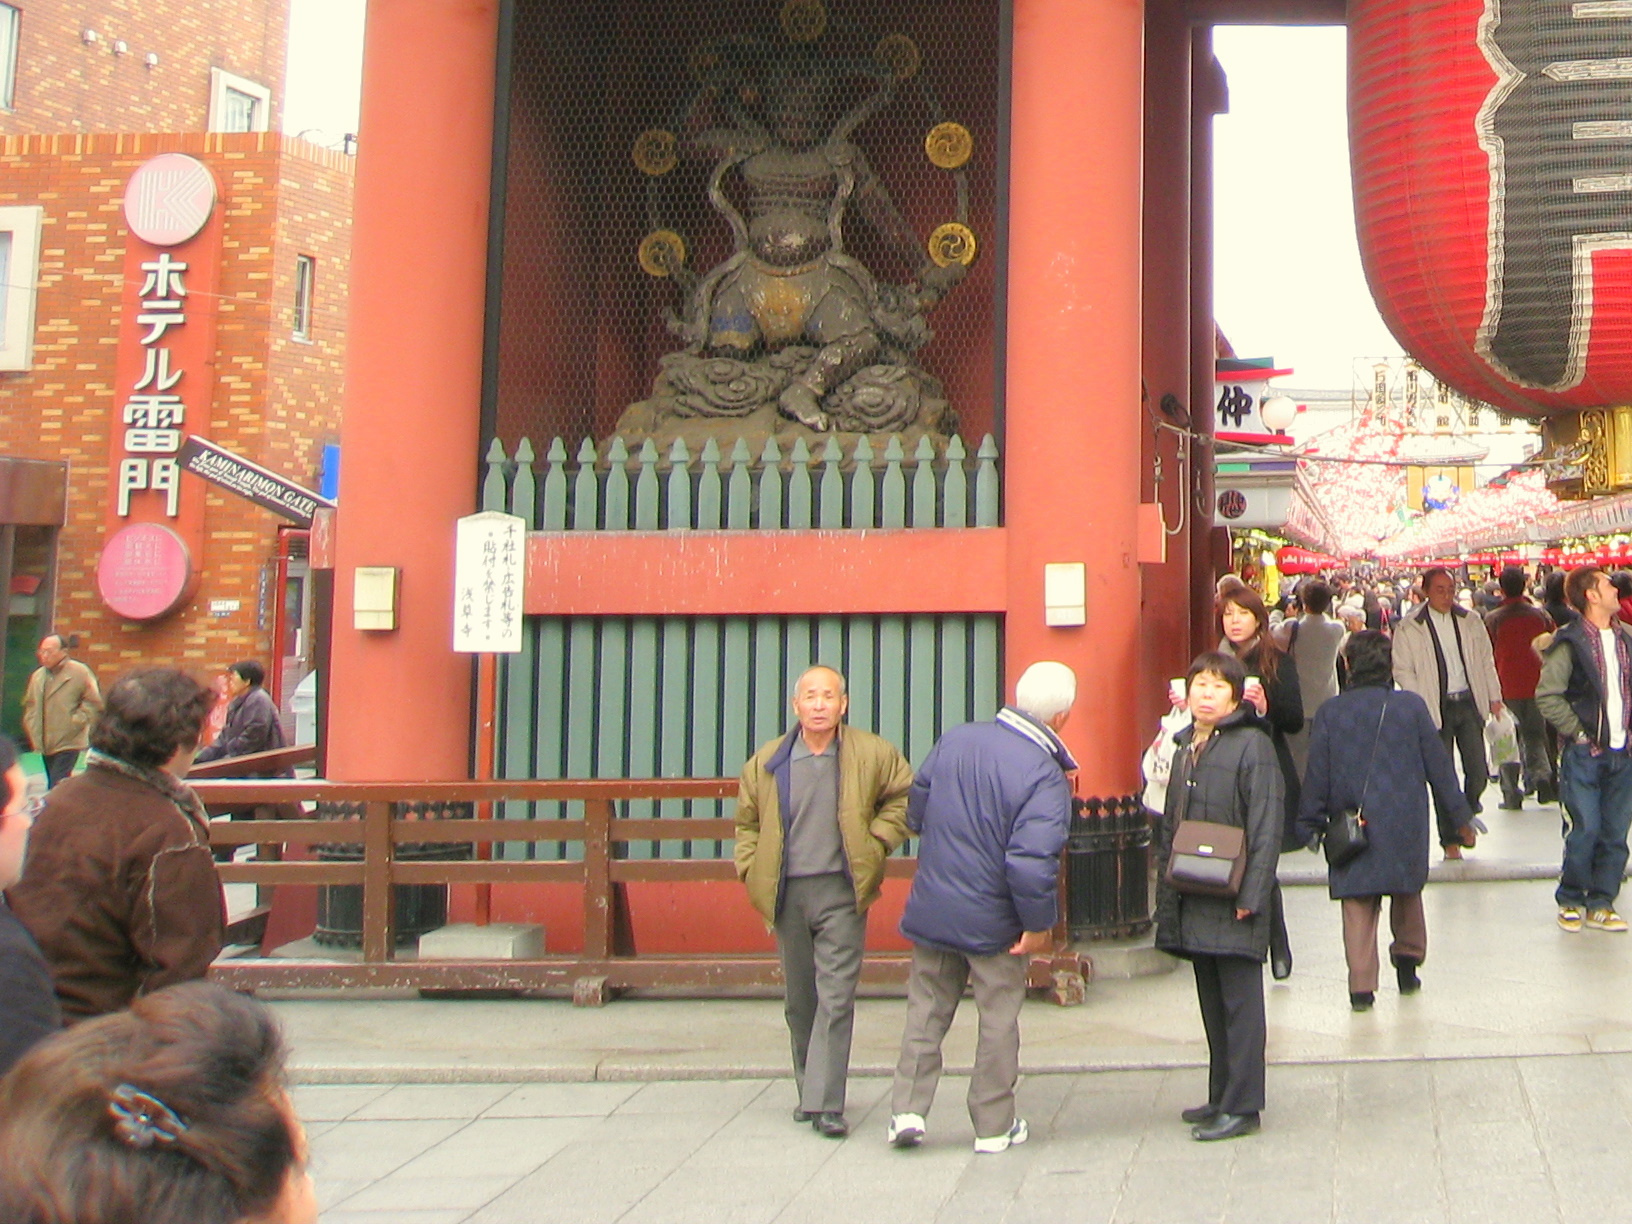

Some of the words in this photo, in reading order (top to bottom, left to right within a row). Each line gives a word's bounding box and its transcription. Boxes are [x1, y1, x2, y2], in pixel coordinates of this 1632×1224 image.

[117, 252, 188, 518] ホテル雷門
[1217, 385, 1253, 428] 仲
[198, 449, 285, 498] KAMINARIMON
[283, 490, 318, 514] GATE
[461, 586, 475, 638] 浅草寺
